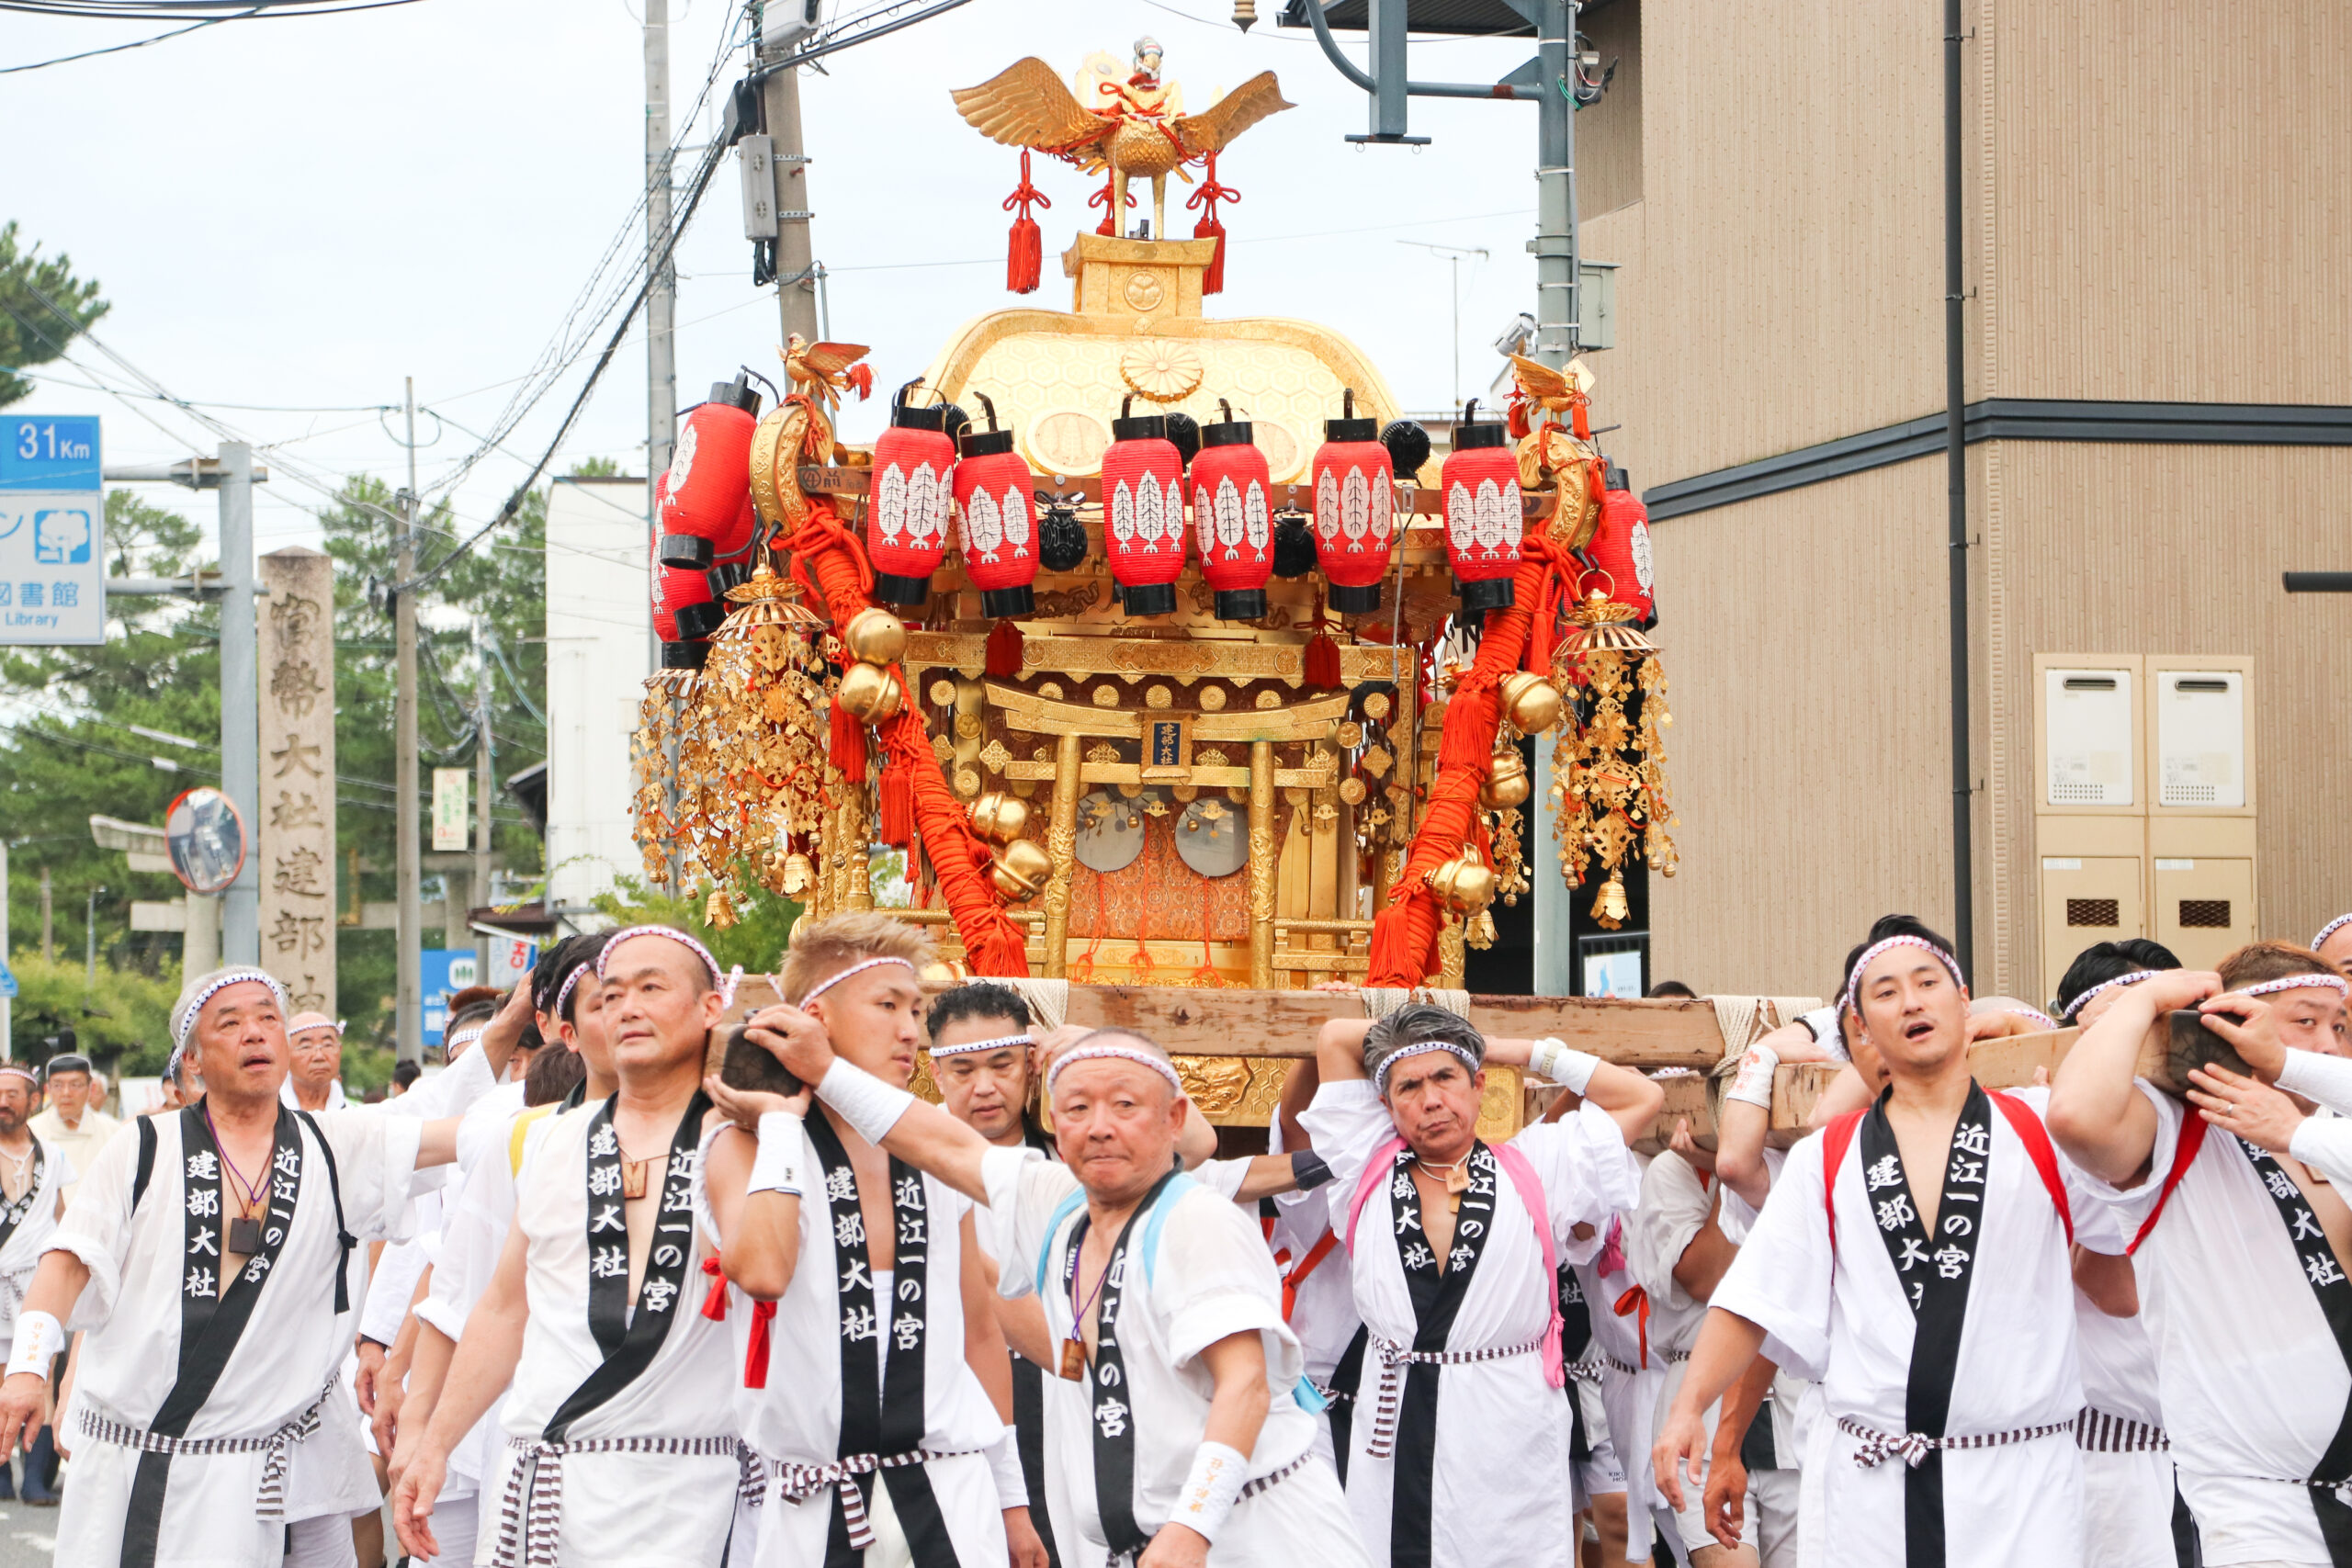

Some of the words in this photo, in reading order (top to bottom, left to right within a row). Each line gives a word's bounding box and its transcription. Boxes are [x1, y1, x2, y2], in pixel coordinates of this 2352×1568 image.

[6, 612, 60, 628] Library
[1160, 722, 1177, 765] 建部大社
[184, 1149, 219, 1298] 建部大社
[244, 1145, 300, 1283] 近江一の宮
[588, 1123, 628, 1279] 建部大社
[643, 1146, 697, 1313] 近江一の宮
[826, 1166, 878, 1343] 建部大社
[892, 1177, 927, 1351] 近江一の宮
[1449, 1148, 1496, 1272] 近江一の宮
[1933, 1122, 1989, 1280] 近江一の宮
[1560, 1258, 1584, 1304] 社
